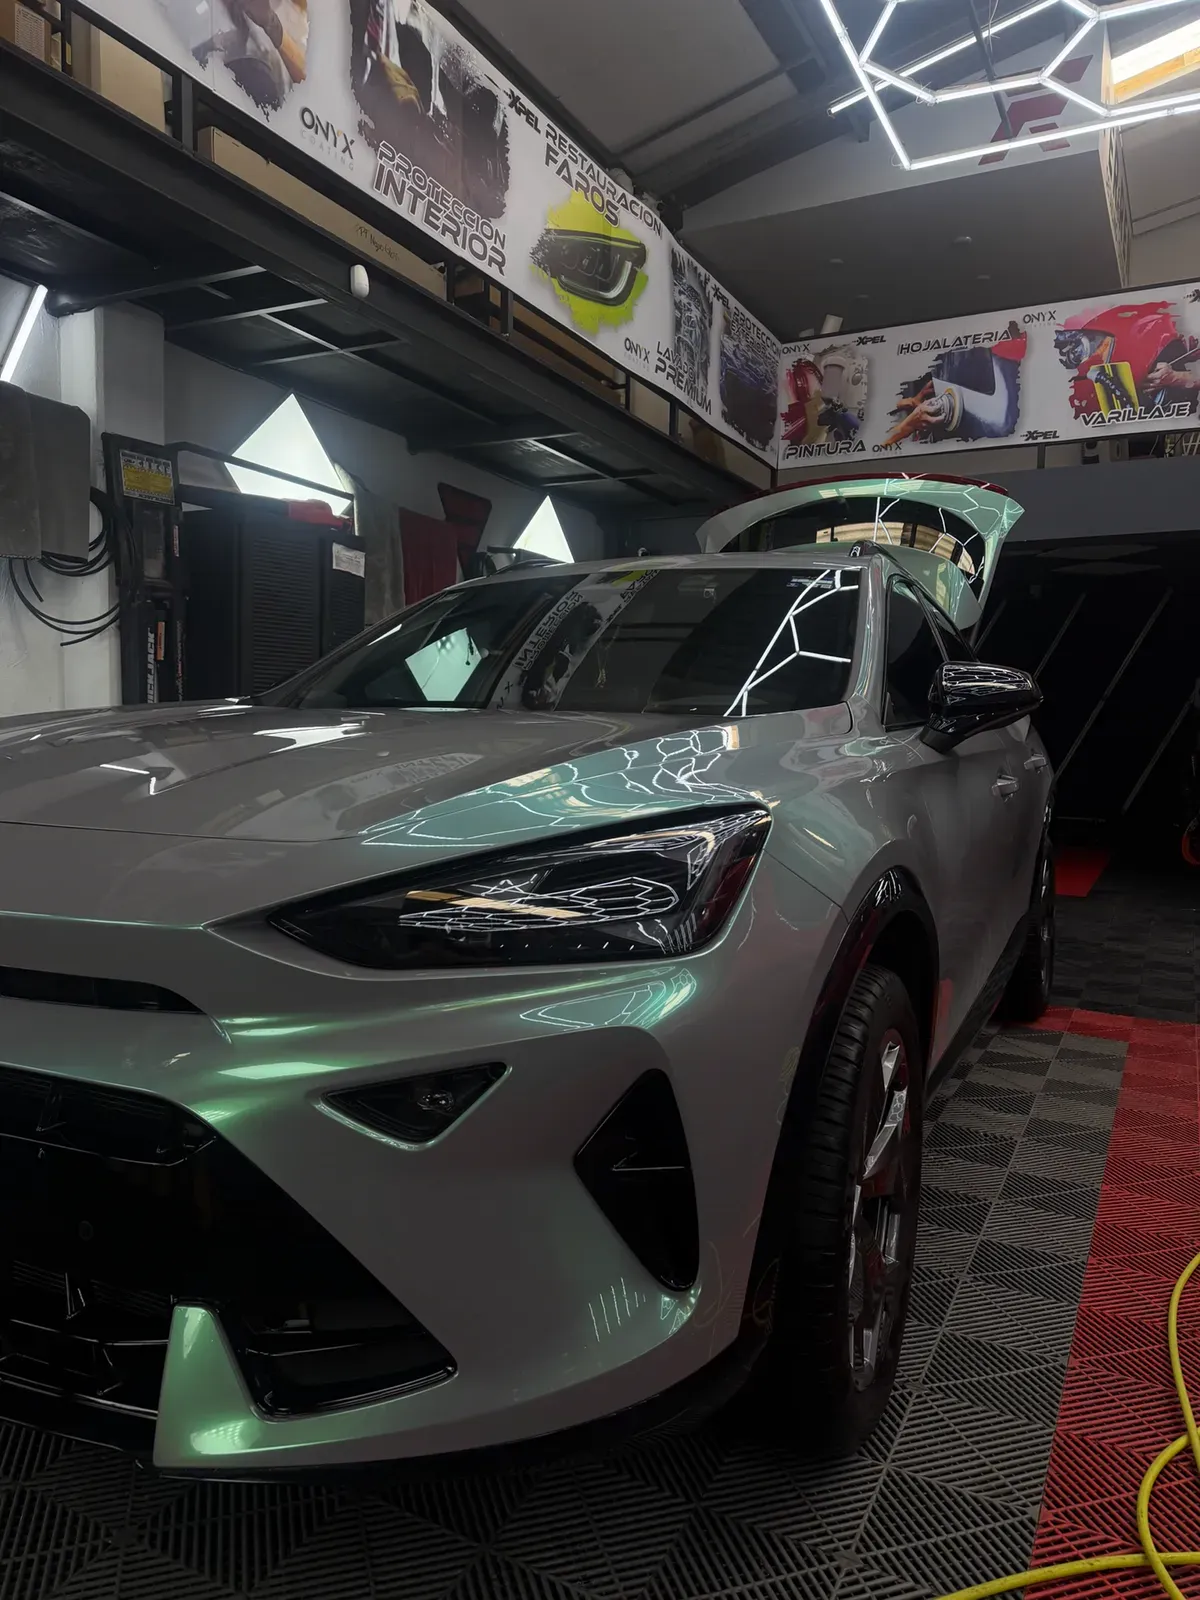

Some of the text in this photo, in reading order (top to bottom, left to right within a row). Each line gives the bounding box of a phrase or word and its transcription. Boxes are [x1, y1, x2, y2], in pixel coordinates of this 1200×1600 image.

[505, 88, 541, 134] XPEL
[301, 107, 355, 160] ONYX
[544, 142, 620, 228] FAROS
[545, 123, 663, 237] RESTAURACION
[378, 140, 506, 250] PROTECCION
[374, 162, 506, 277] INTERIOR
[711, 284, 730, 310] XPEL
[1023, 310, 1057, 324] ONYX
[624, 337, 650, 364] ONYX
[782, 343, 810, 355] ONYX
[855, 335, 886, 347] XPEL
[898, 328, 1012, 356] HOJALATERIA
[656, 341, 696, 381] LAVADO
[655, 357, 712, 415] PREMIUM
[1081, 401, 1191, 427] VARILLAJE
[872, 442, 902, 453] ONYX
[1023, 430, 1060, 442] XPEL
[785, 440, 867, 460] PINTURA
